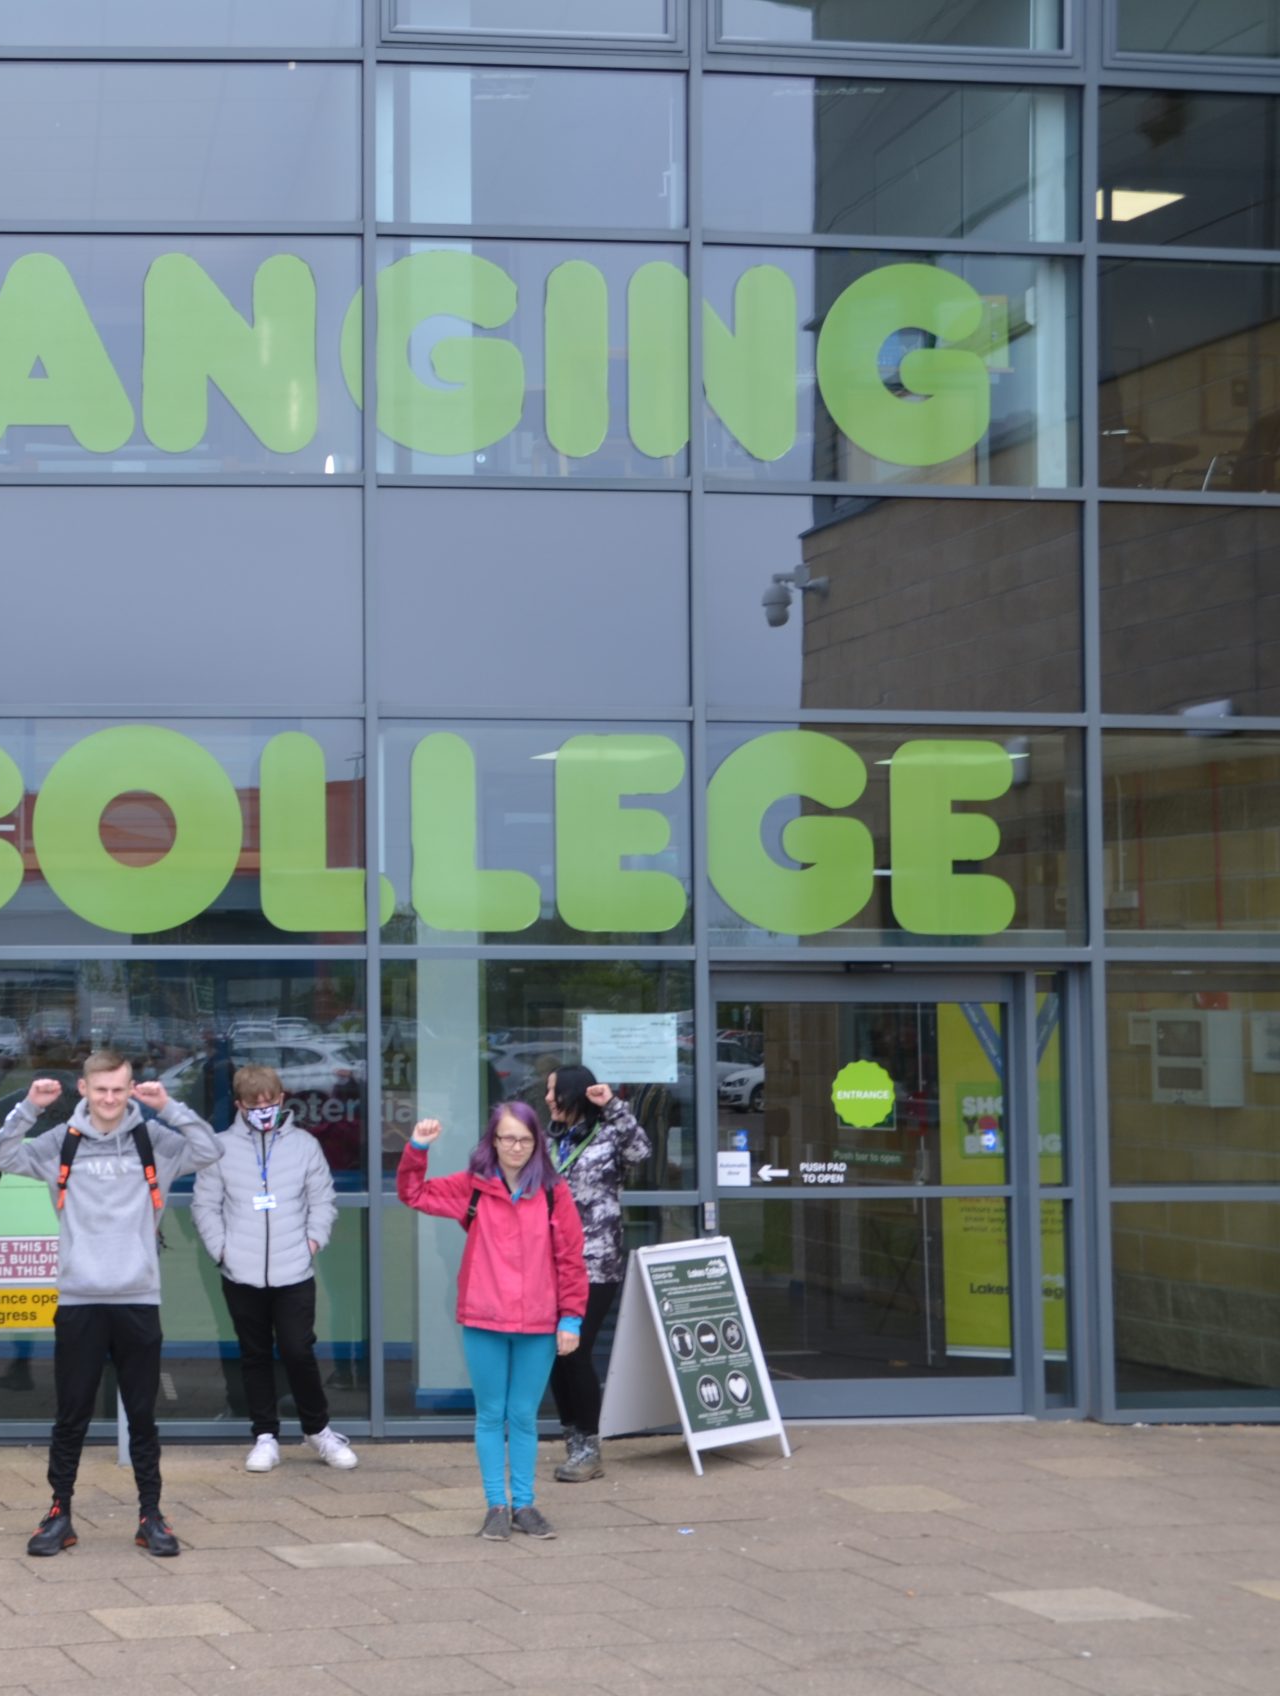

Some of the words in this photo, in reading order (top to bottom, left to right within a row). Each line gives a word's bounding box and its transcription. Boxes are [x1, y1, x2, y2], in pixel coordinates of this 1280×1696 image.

[836, 1089, 891, 1101] ENTRANCE
[800, 1162, 826, 1173] PUSH
[827, 1162, 847, 1173] PAD
[802, 1174, 816, 1184] TO
[817, 1174, 844, 1184] OPEN
[12, 1241, 42, 1252] THIS
[46, 1241, 58, 1252] IS
[0, 1266, 12, 1277] IN
[16, 1265, 46, 1277] THIS
